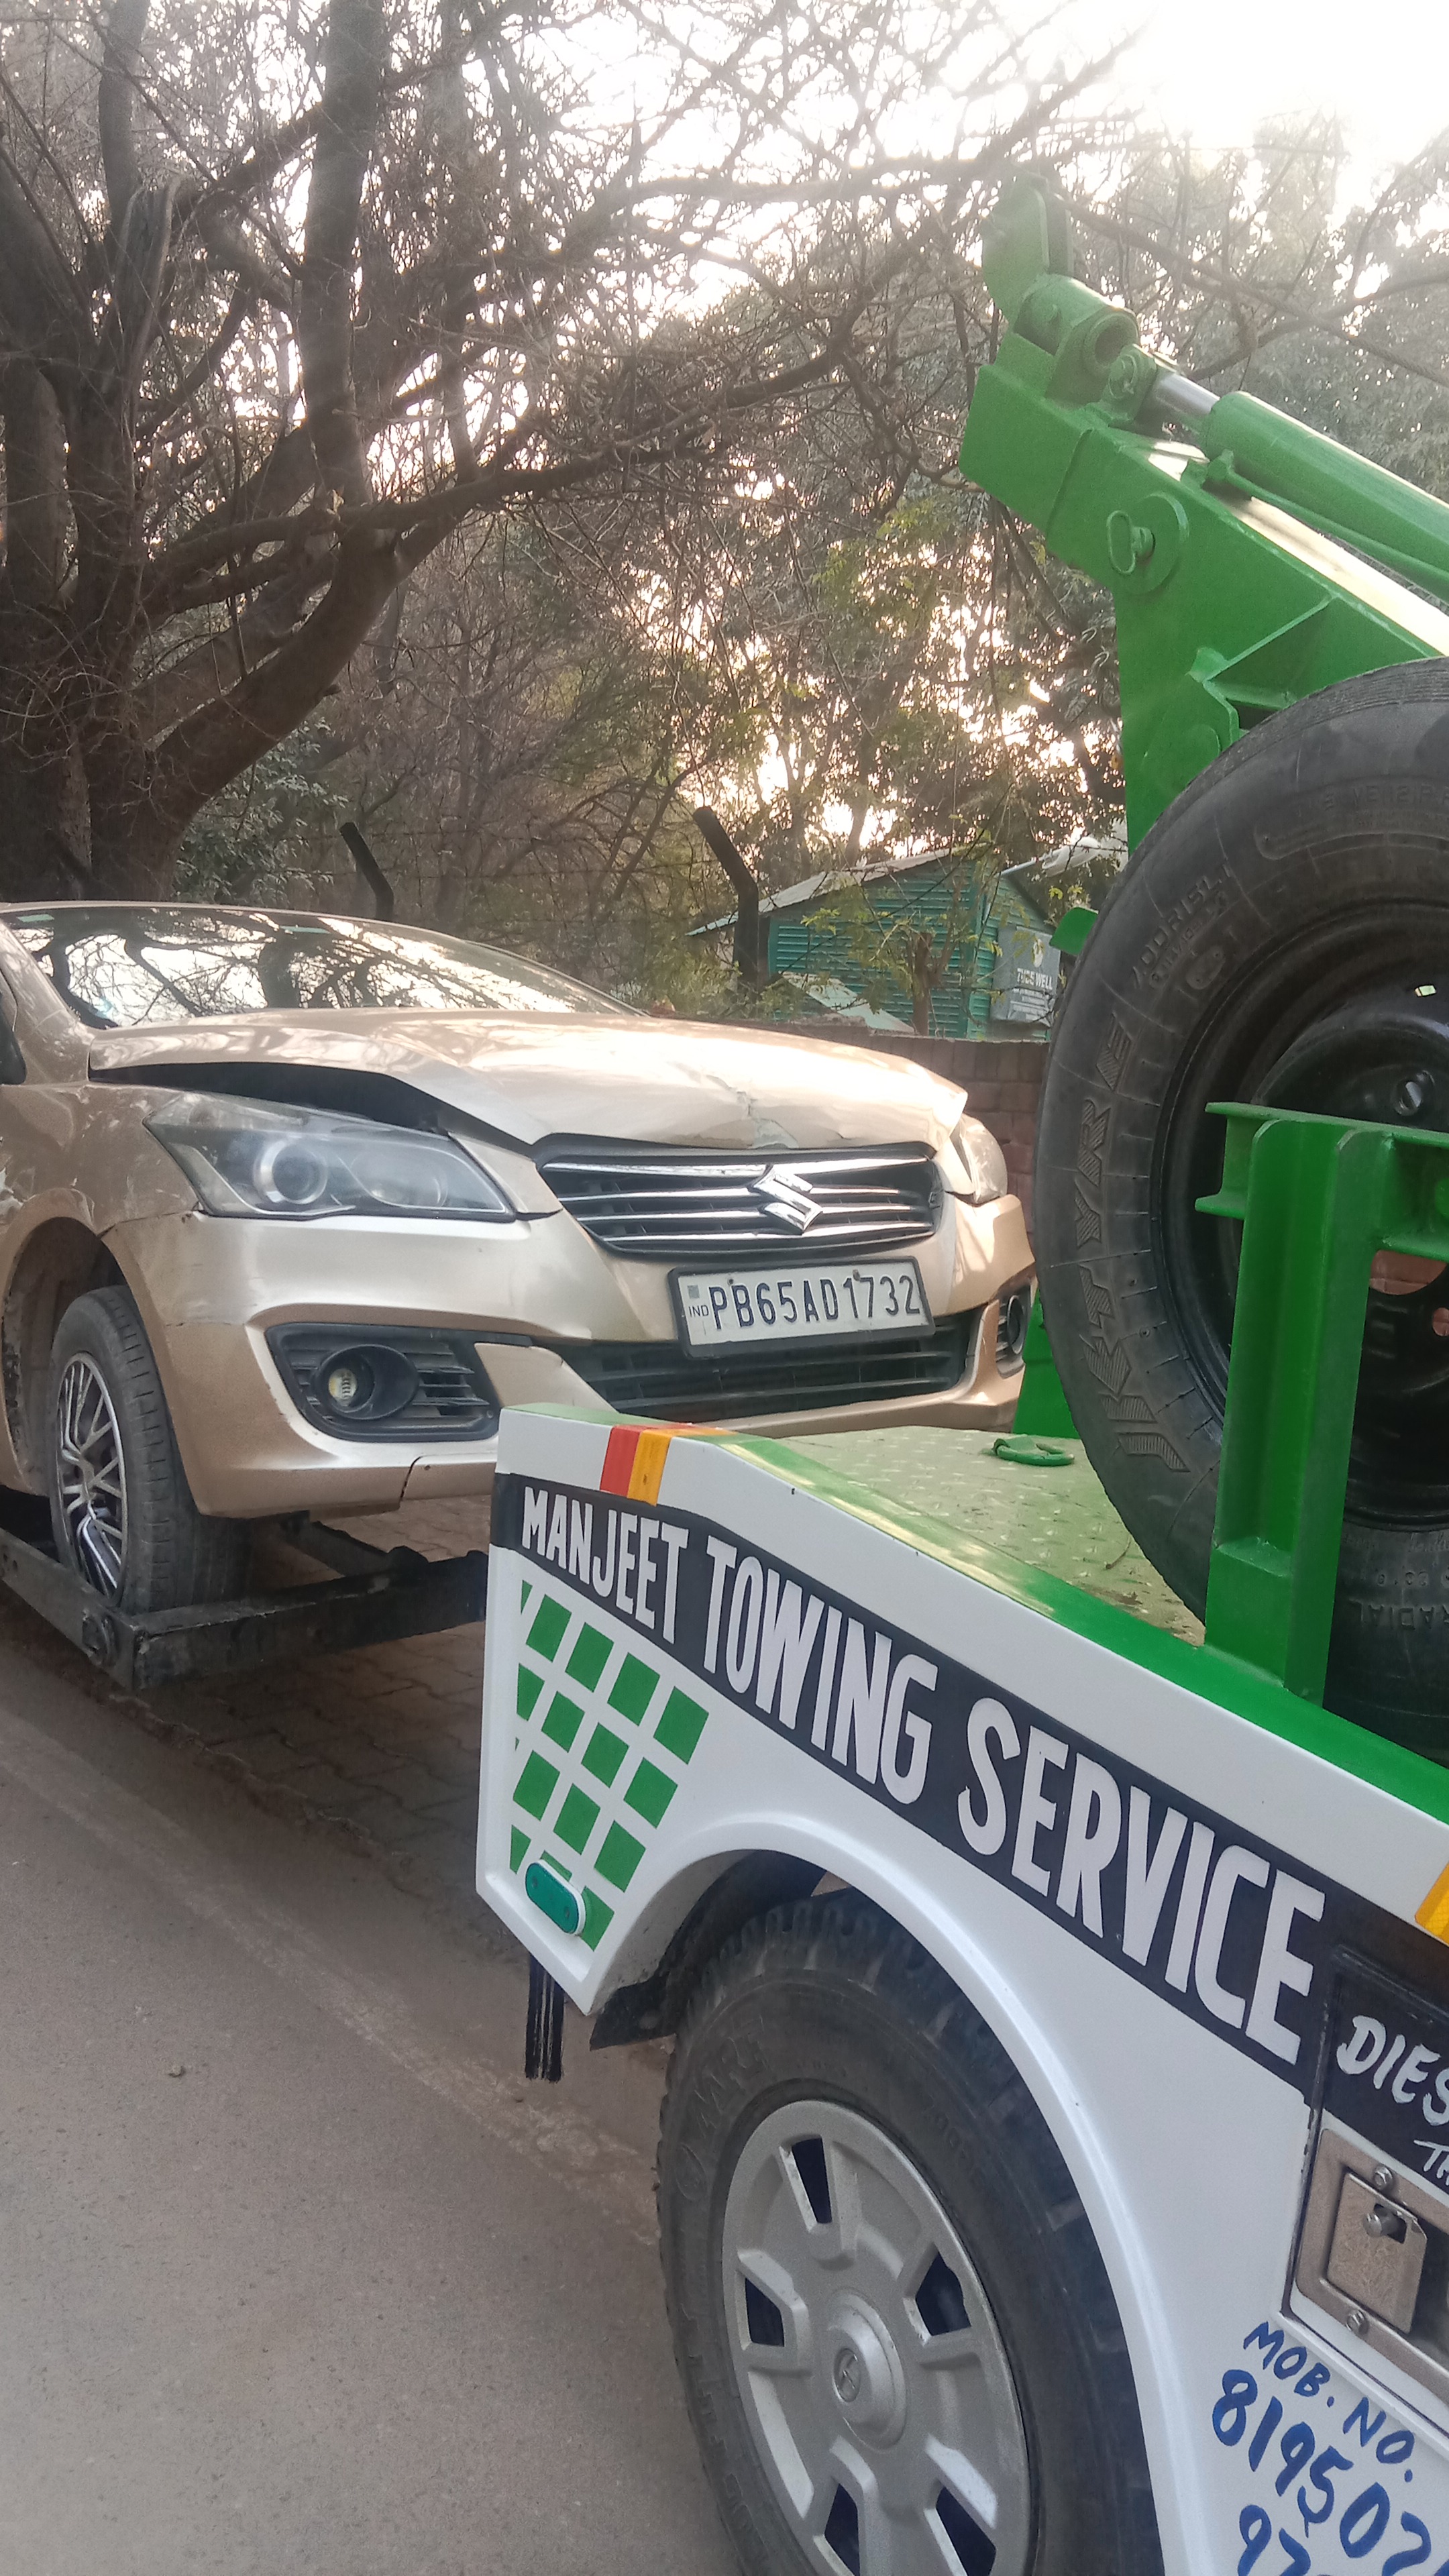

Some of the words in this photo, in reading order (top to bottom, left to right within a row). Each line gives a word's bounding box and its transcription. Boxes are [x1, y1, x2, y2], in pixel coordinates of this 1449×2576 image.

[1035, 972, 1053, 990] WELL
[688, 1303, 709, 1318] IND
[708, 1275, 920, 1330] PB65AD1732
[521, 1486, 689, 1645] MANJEET
[703, 1536, 938, 1805] TOWING
[957, 1697, 1326, 2065] SERVICE
[1243, 2320, 1335, 2408] MOB.
[1342, 2396, 1415, 2483] NO.
